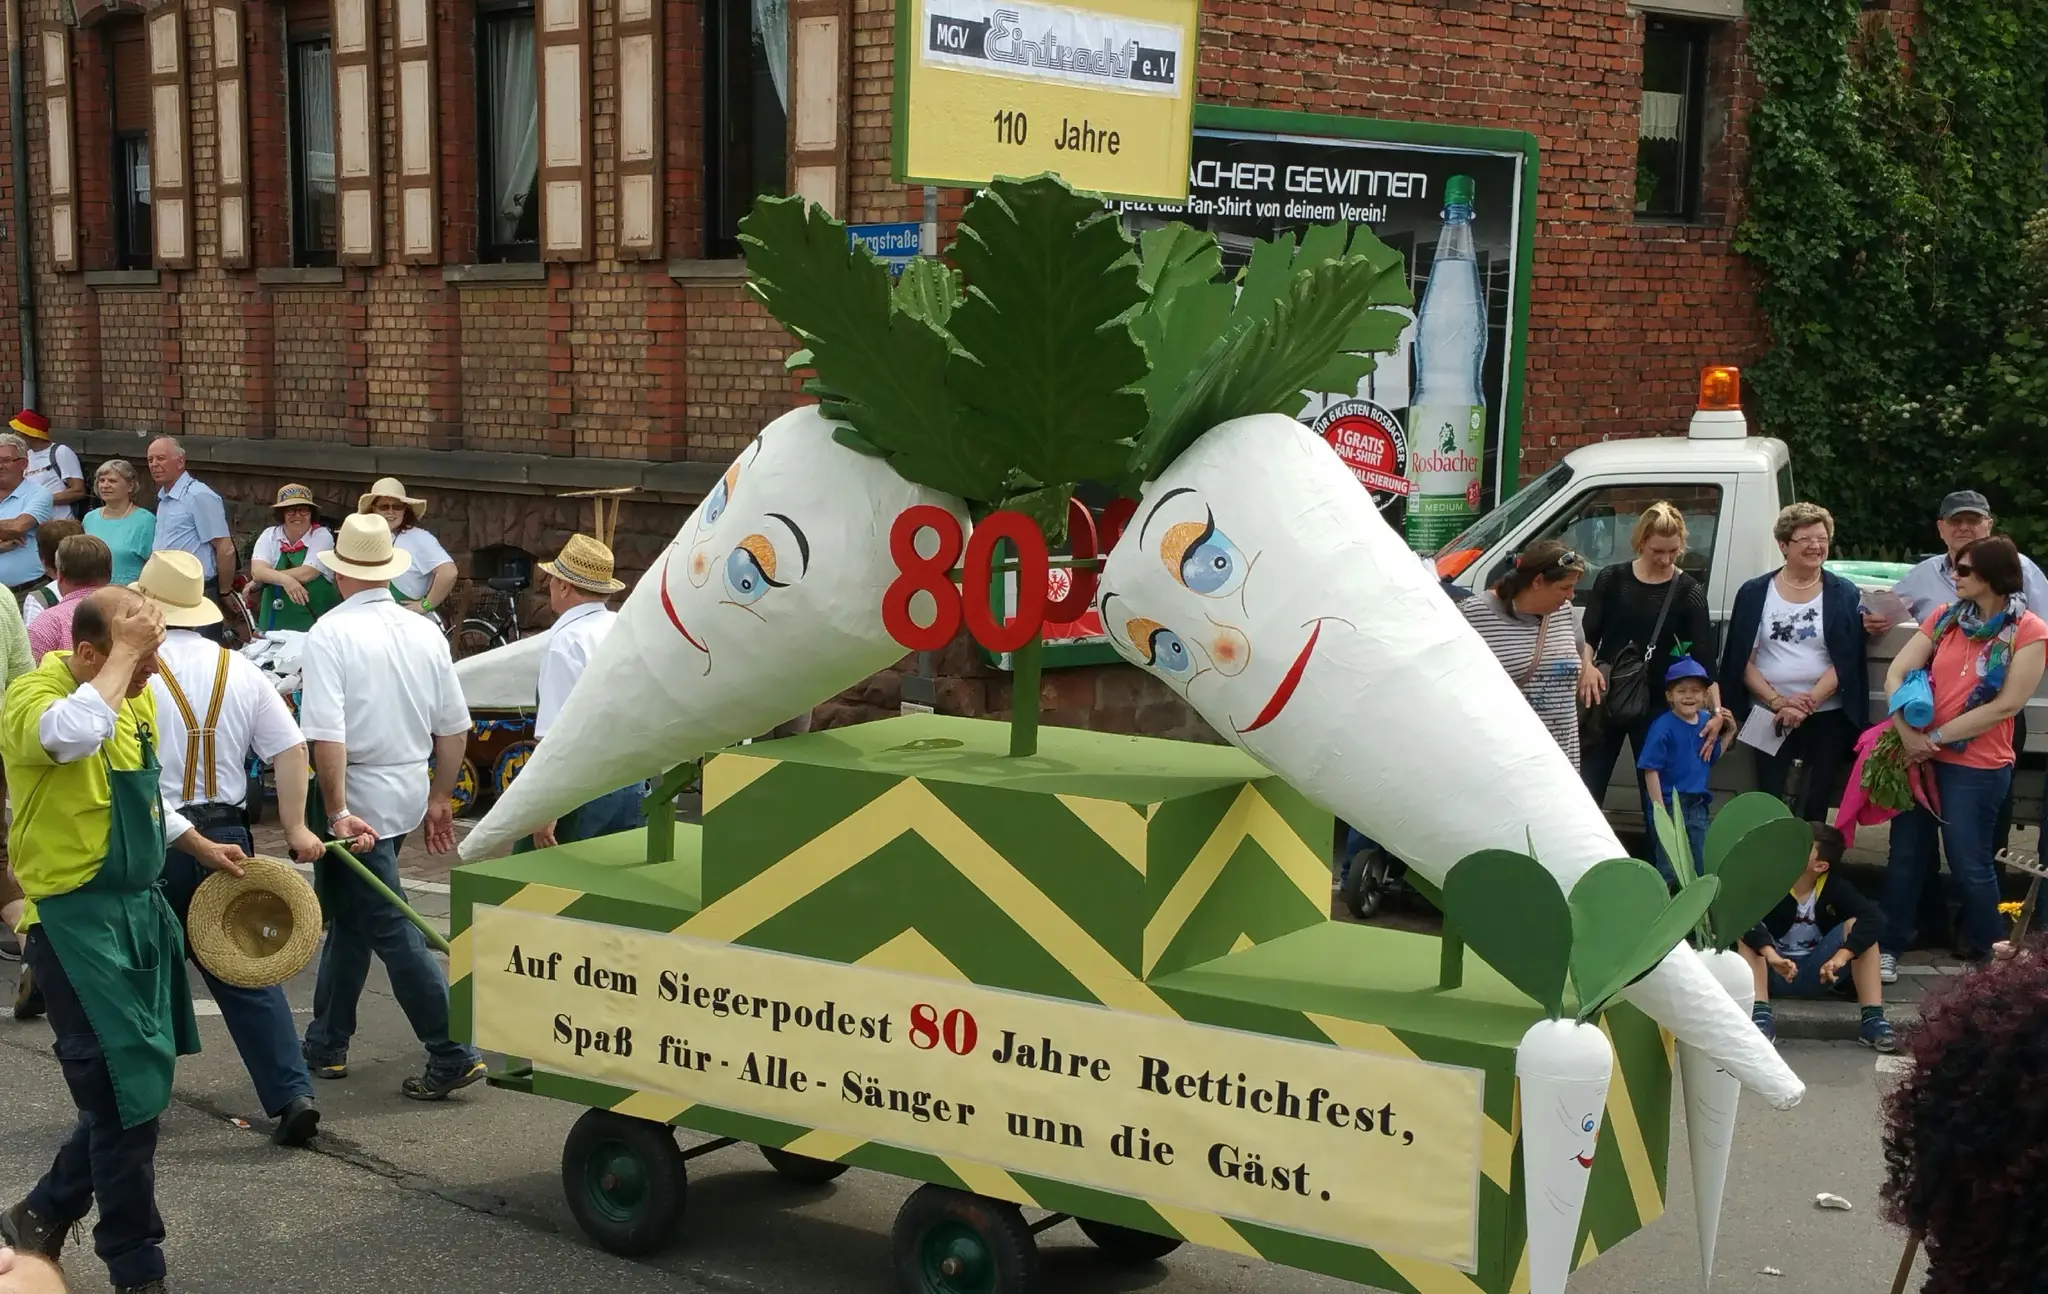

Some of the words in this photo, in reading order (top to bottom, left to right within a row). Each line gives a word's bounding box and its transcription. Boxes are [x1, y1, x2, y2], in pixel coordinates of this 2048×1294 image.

[937, 23, 969, 49] MGV
[984, 9, 1136, 79] Eintracht
[1142, 56, 1175, 79] e.V.
[993, 109, 1028, 146] 110
[1054, 118, 1121, 155] Jahre
[1285, 165, 1428, 199] GEWINNEN
[1187, 195, 1252, 217] Fan-Shirt
[1256, 202, 1281, 217] von
[1284, 198, 1335, 220] deinem
[1340, 202, 1388, 222] Verein!
[1329, 411, 1337, 422] 6
[1335, 403, 1371, 419] KÄSTEN
[1370, 407, 1406, 463] ROSBACHER
[1337, 428, 1343, 443] 1
[1344, 430, 1386, 454] GRATIS
[1334, 443, 1383, 467] FAN-SHIRT
[1412, 449, 1479, 473] Rosbacher
[1425, 504, 1464, 514] MEDIUM
[882, 504, 1049, 652] 80
[504, 944, 562, 981] Auf
[574, 956, 638, 996] dem
[658, 970, 893, 1044] Siegerpodest
[908, 1003, 978, 1056] 80
[992, 1030, 1111, 1081] Jahre
[1137, 1055, 1415, 1147] Rettichfest,
[554, 1013, 633, 1058] Spaß
[841, 1070, 976, 1125] Sänger
[1005, 1111, 1085, 1149] unn
[1110, 1124, 1174, 1166] die
[1207, 1142, 1331, 1202] Gäst.
